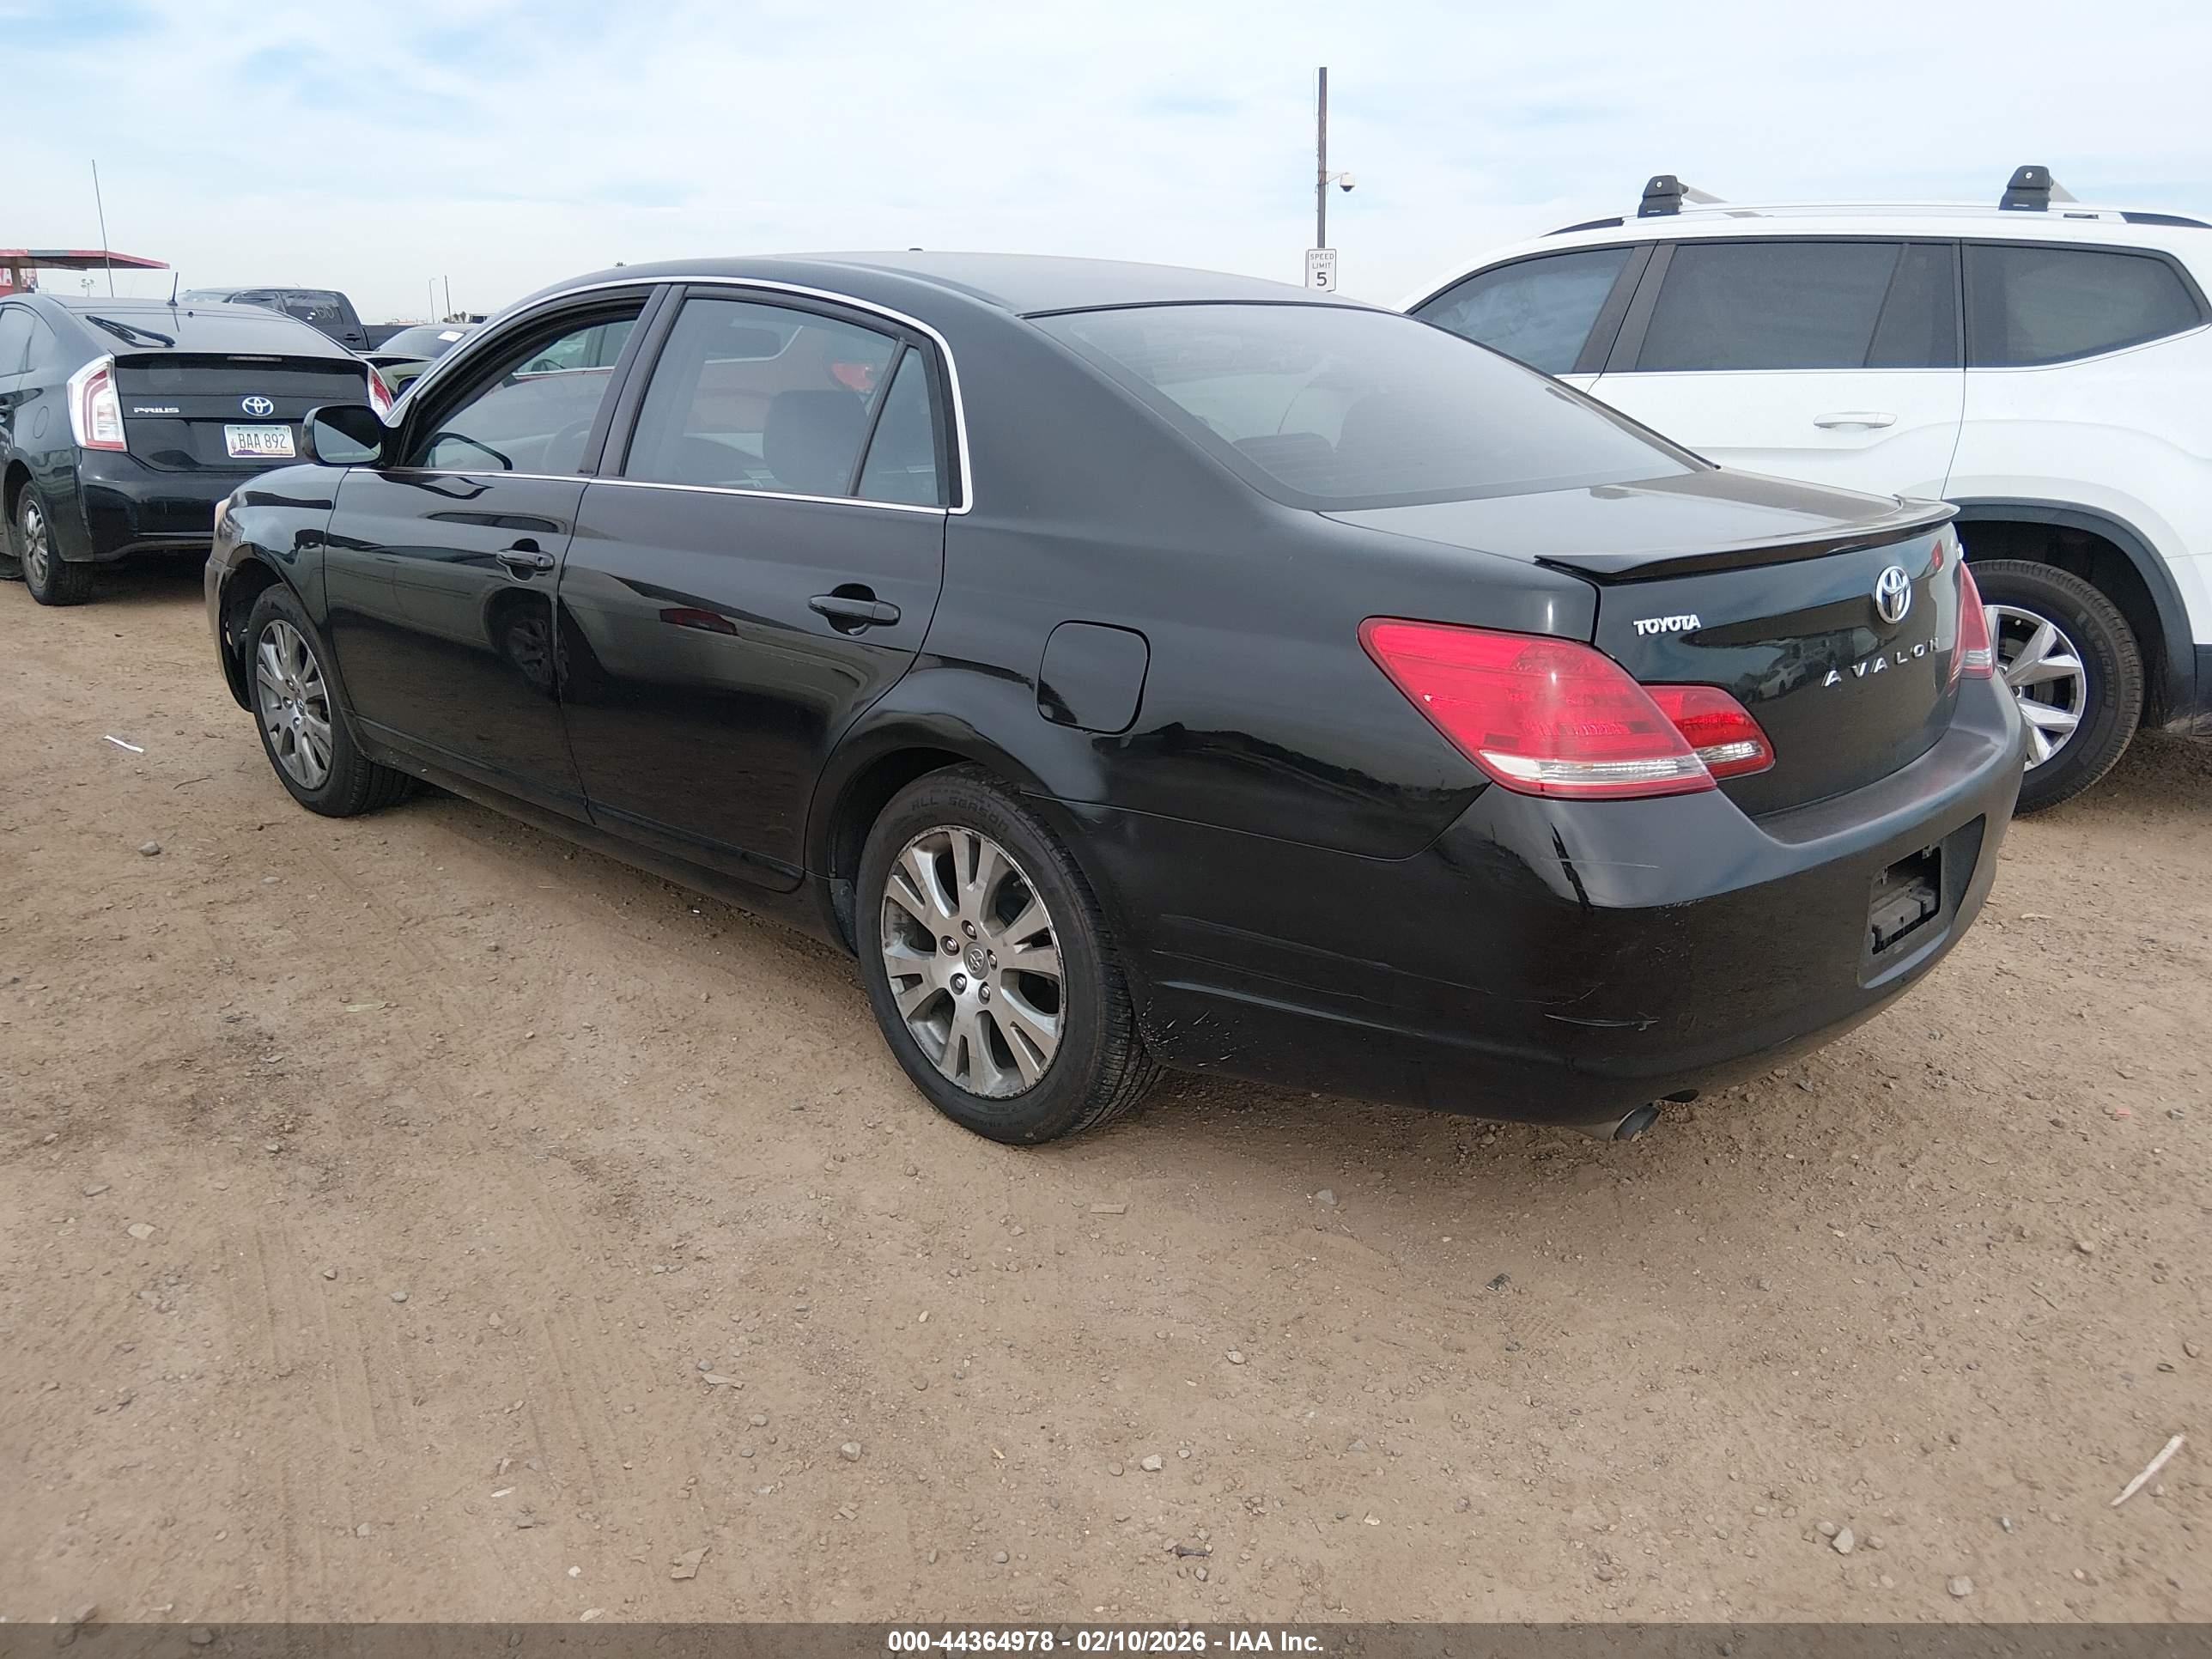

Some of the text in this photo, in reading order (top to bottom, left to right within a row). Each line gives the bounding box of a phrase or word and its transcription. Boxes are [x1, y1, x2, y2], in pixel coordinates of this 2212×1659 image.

[1316, 271, 1328, 287] 5
[238, 433, 288, 449] BAA 892
[1632, 614, 1702, 636] TOYOTA
[1821, 636, 1939, 688] AVALON
